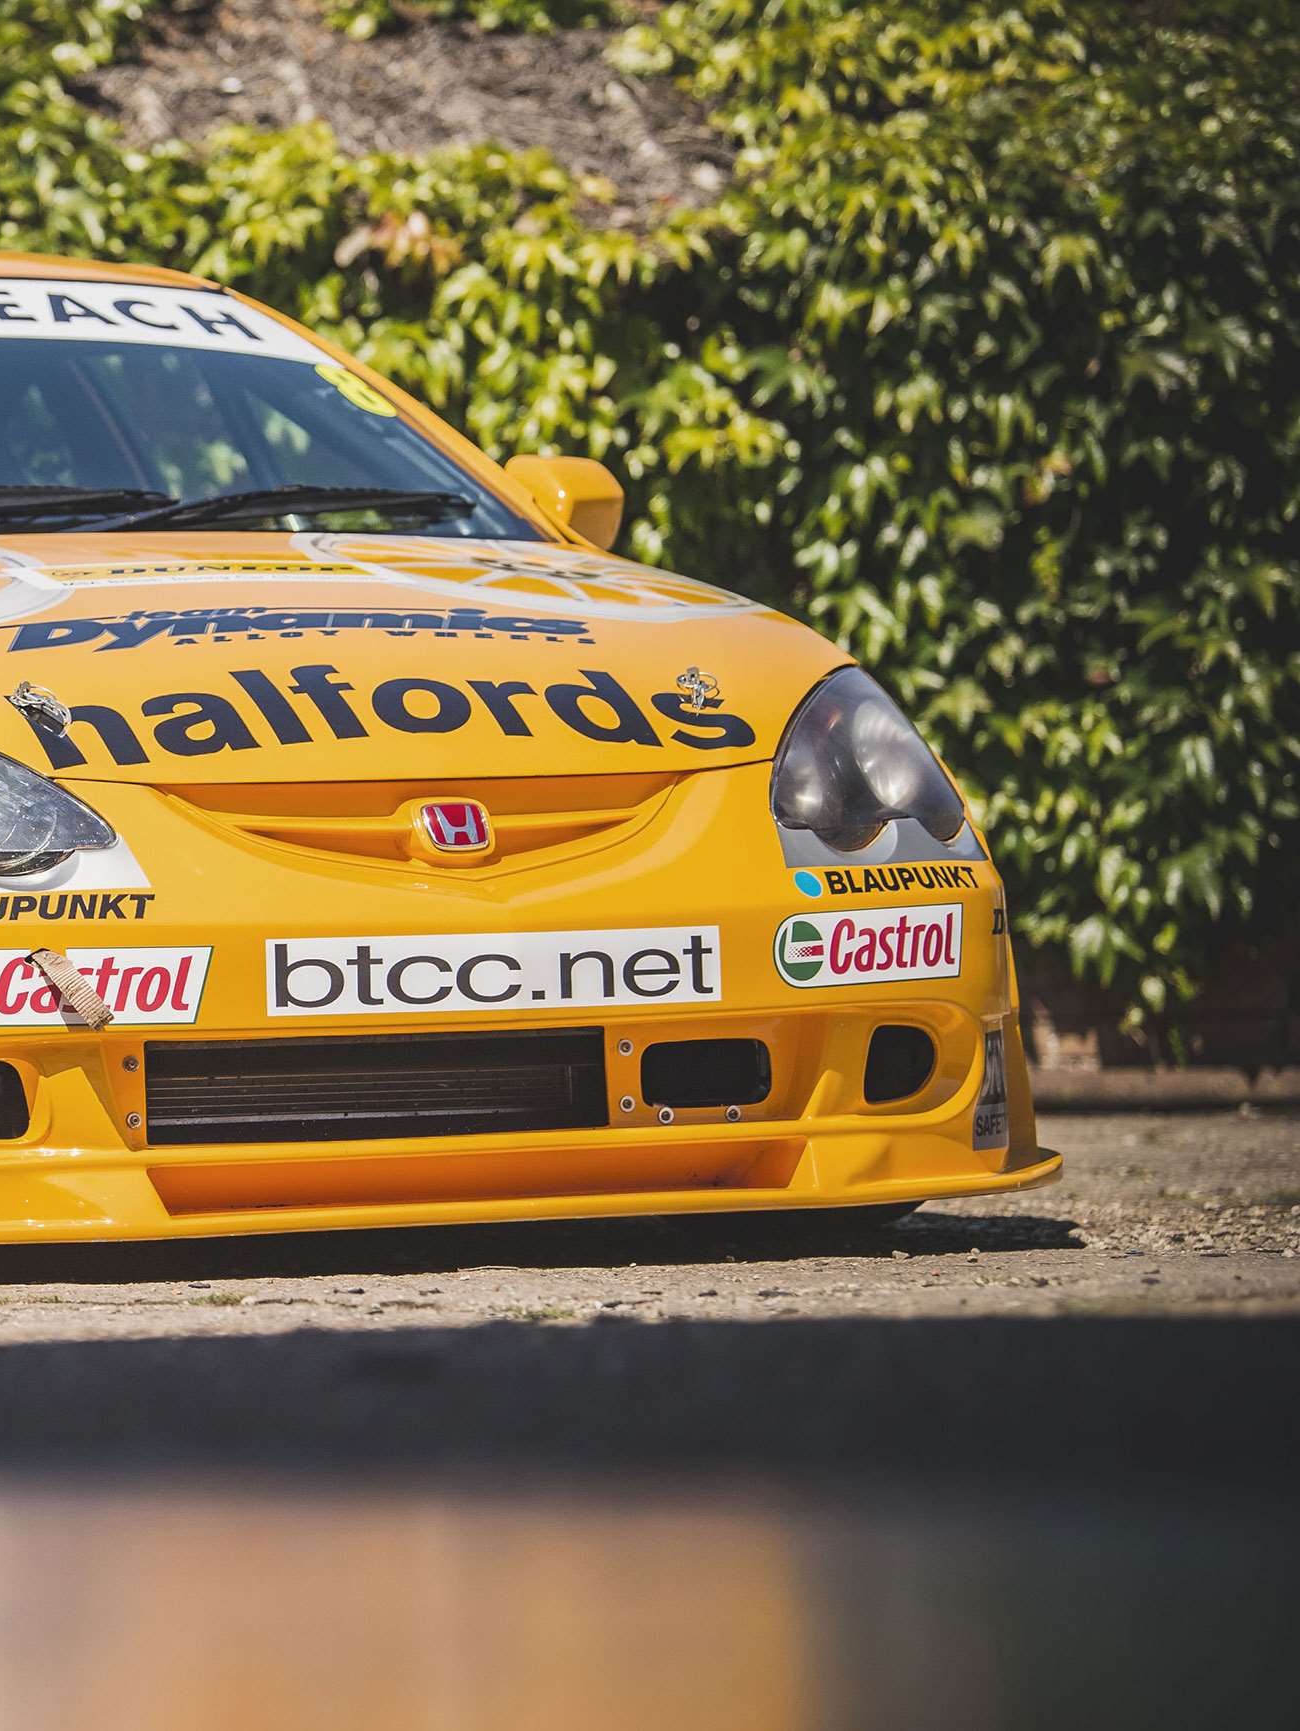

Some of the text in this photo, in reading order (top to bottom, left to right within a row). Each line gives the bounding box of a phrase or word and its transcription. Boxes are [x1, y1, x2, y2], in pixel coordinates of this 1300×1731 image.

[7, 608, 590, 653] Dynamics
[173, 630, 597, 646] ALLOY WHEELS
[4, 664, 756, 770] halfords
[824, 866, 979, 896] BLAUPUNKT
[828, 913, 956, 976] Castrol
[274, 935, 715, 1009] btcc.net
